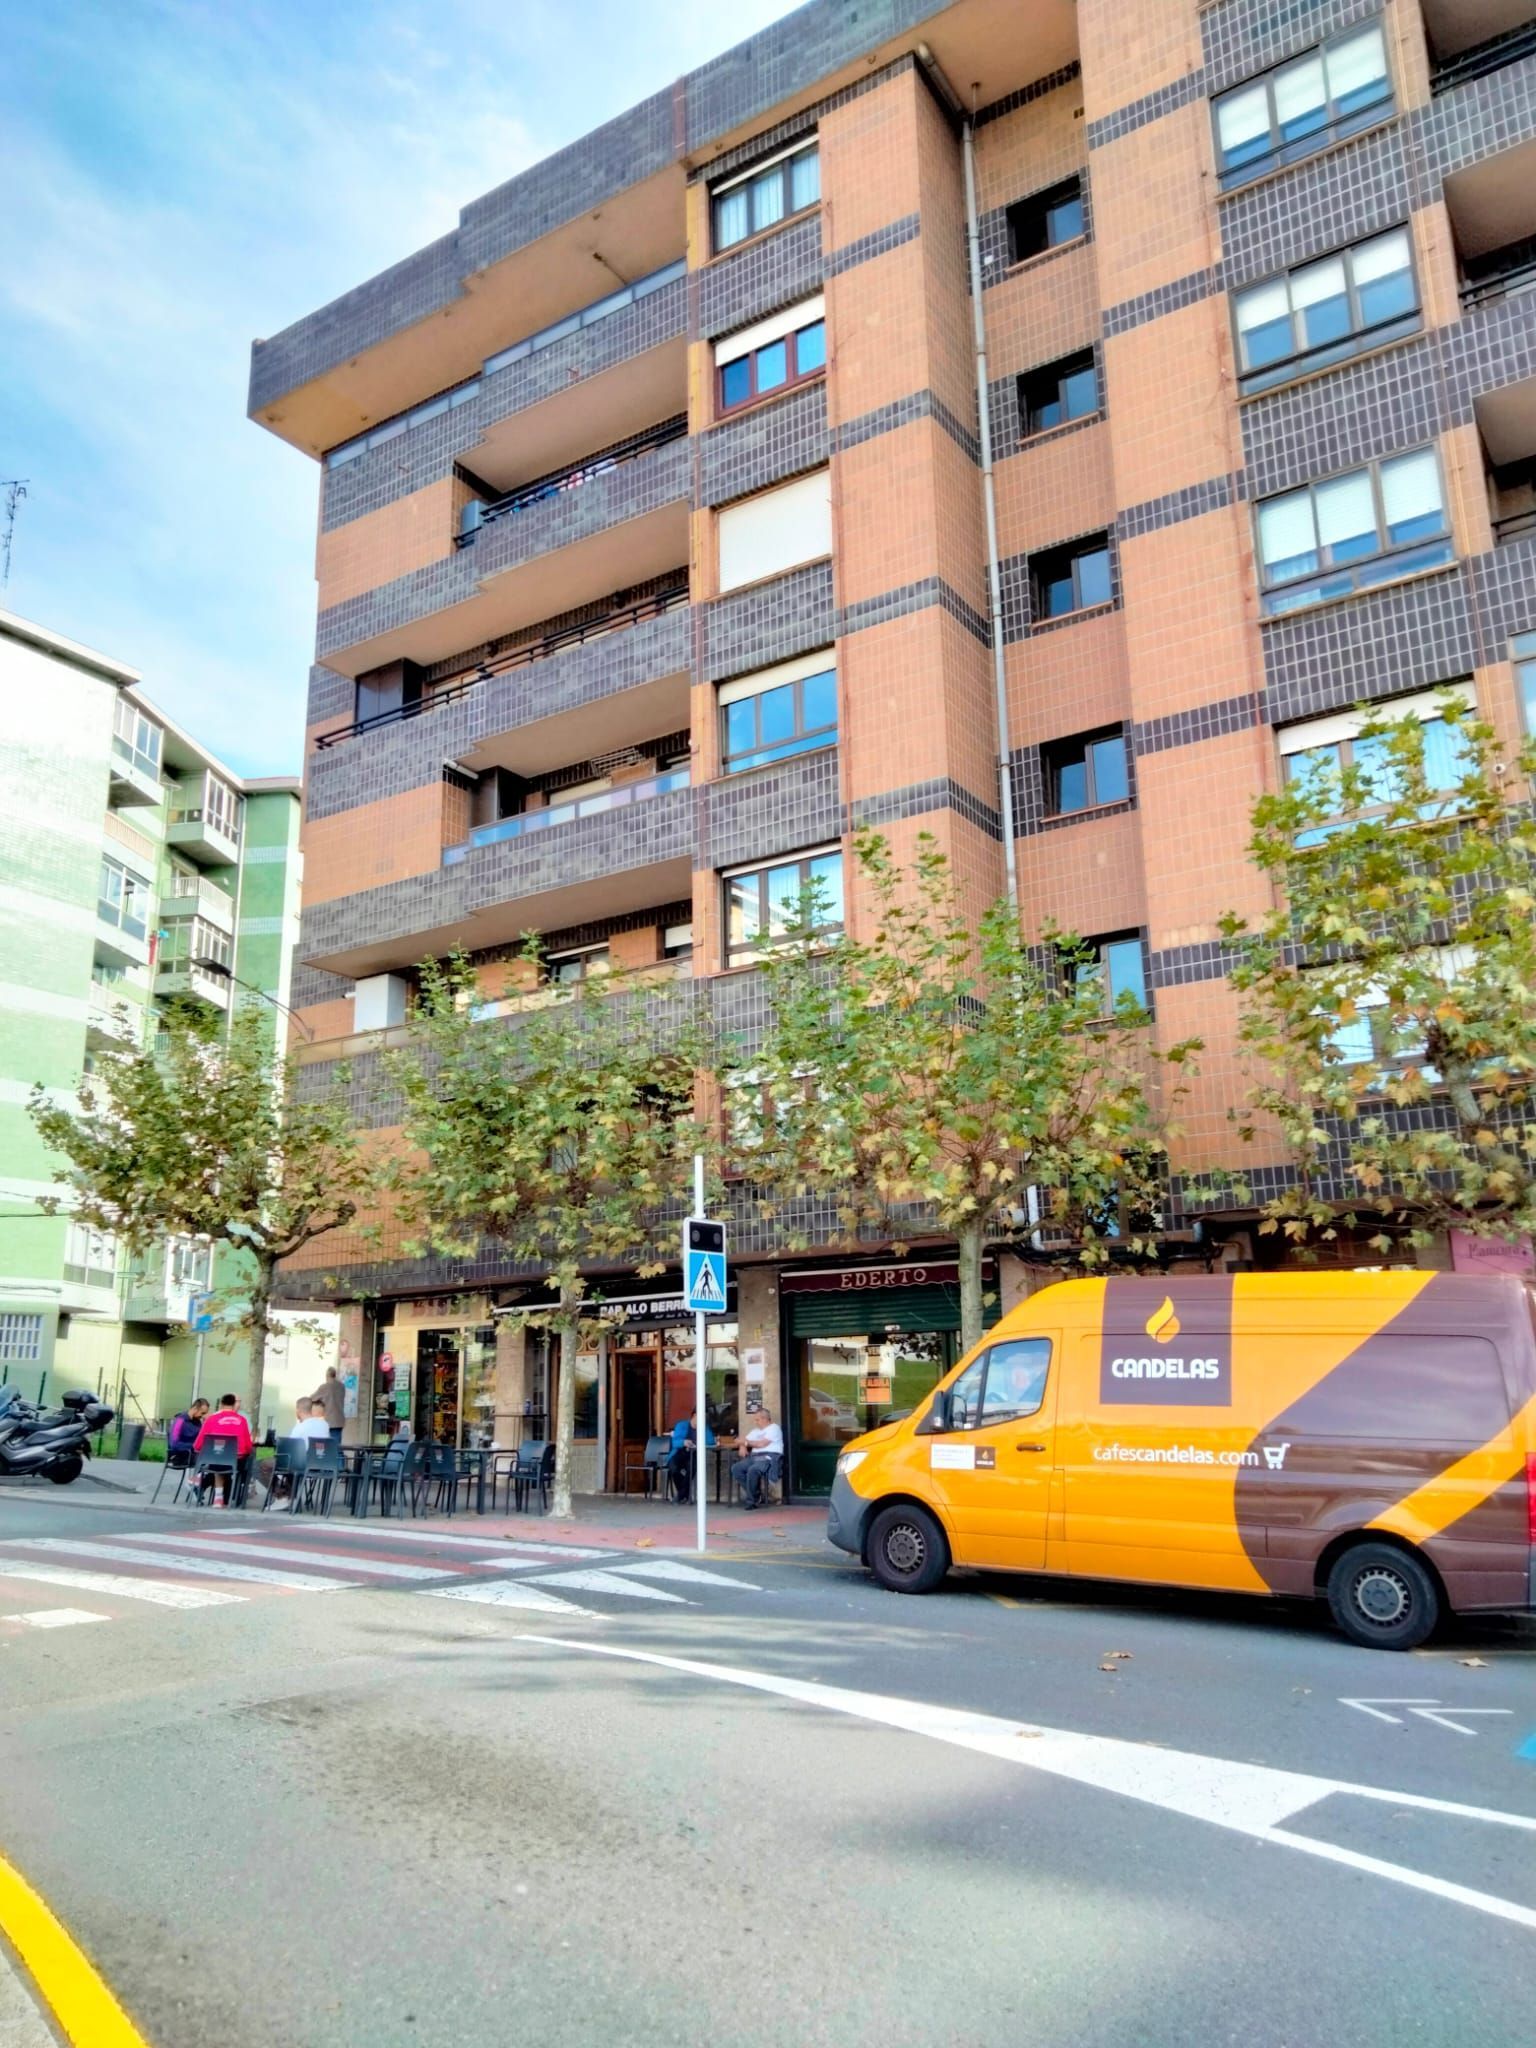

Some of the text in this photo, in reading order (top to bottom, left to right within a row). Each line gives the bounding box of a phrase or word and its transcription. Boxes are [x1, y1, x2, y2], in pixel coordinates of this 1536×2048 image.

[840, 1268, 927, 1288] EDERTO
[625, 1302, 648, 1315] ALO
[1111, 1358, 1220, 1379] CANDELAS
[1093, 1443, 1260, 1467] cafescandelas.com
